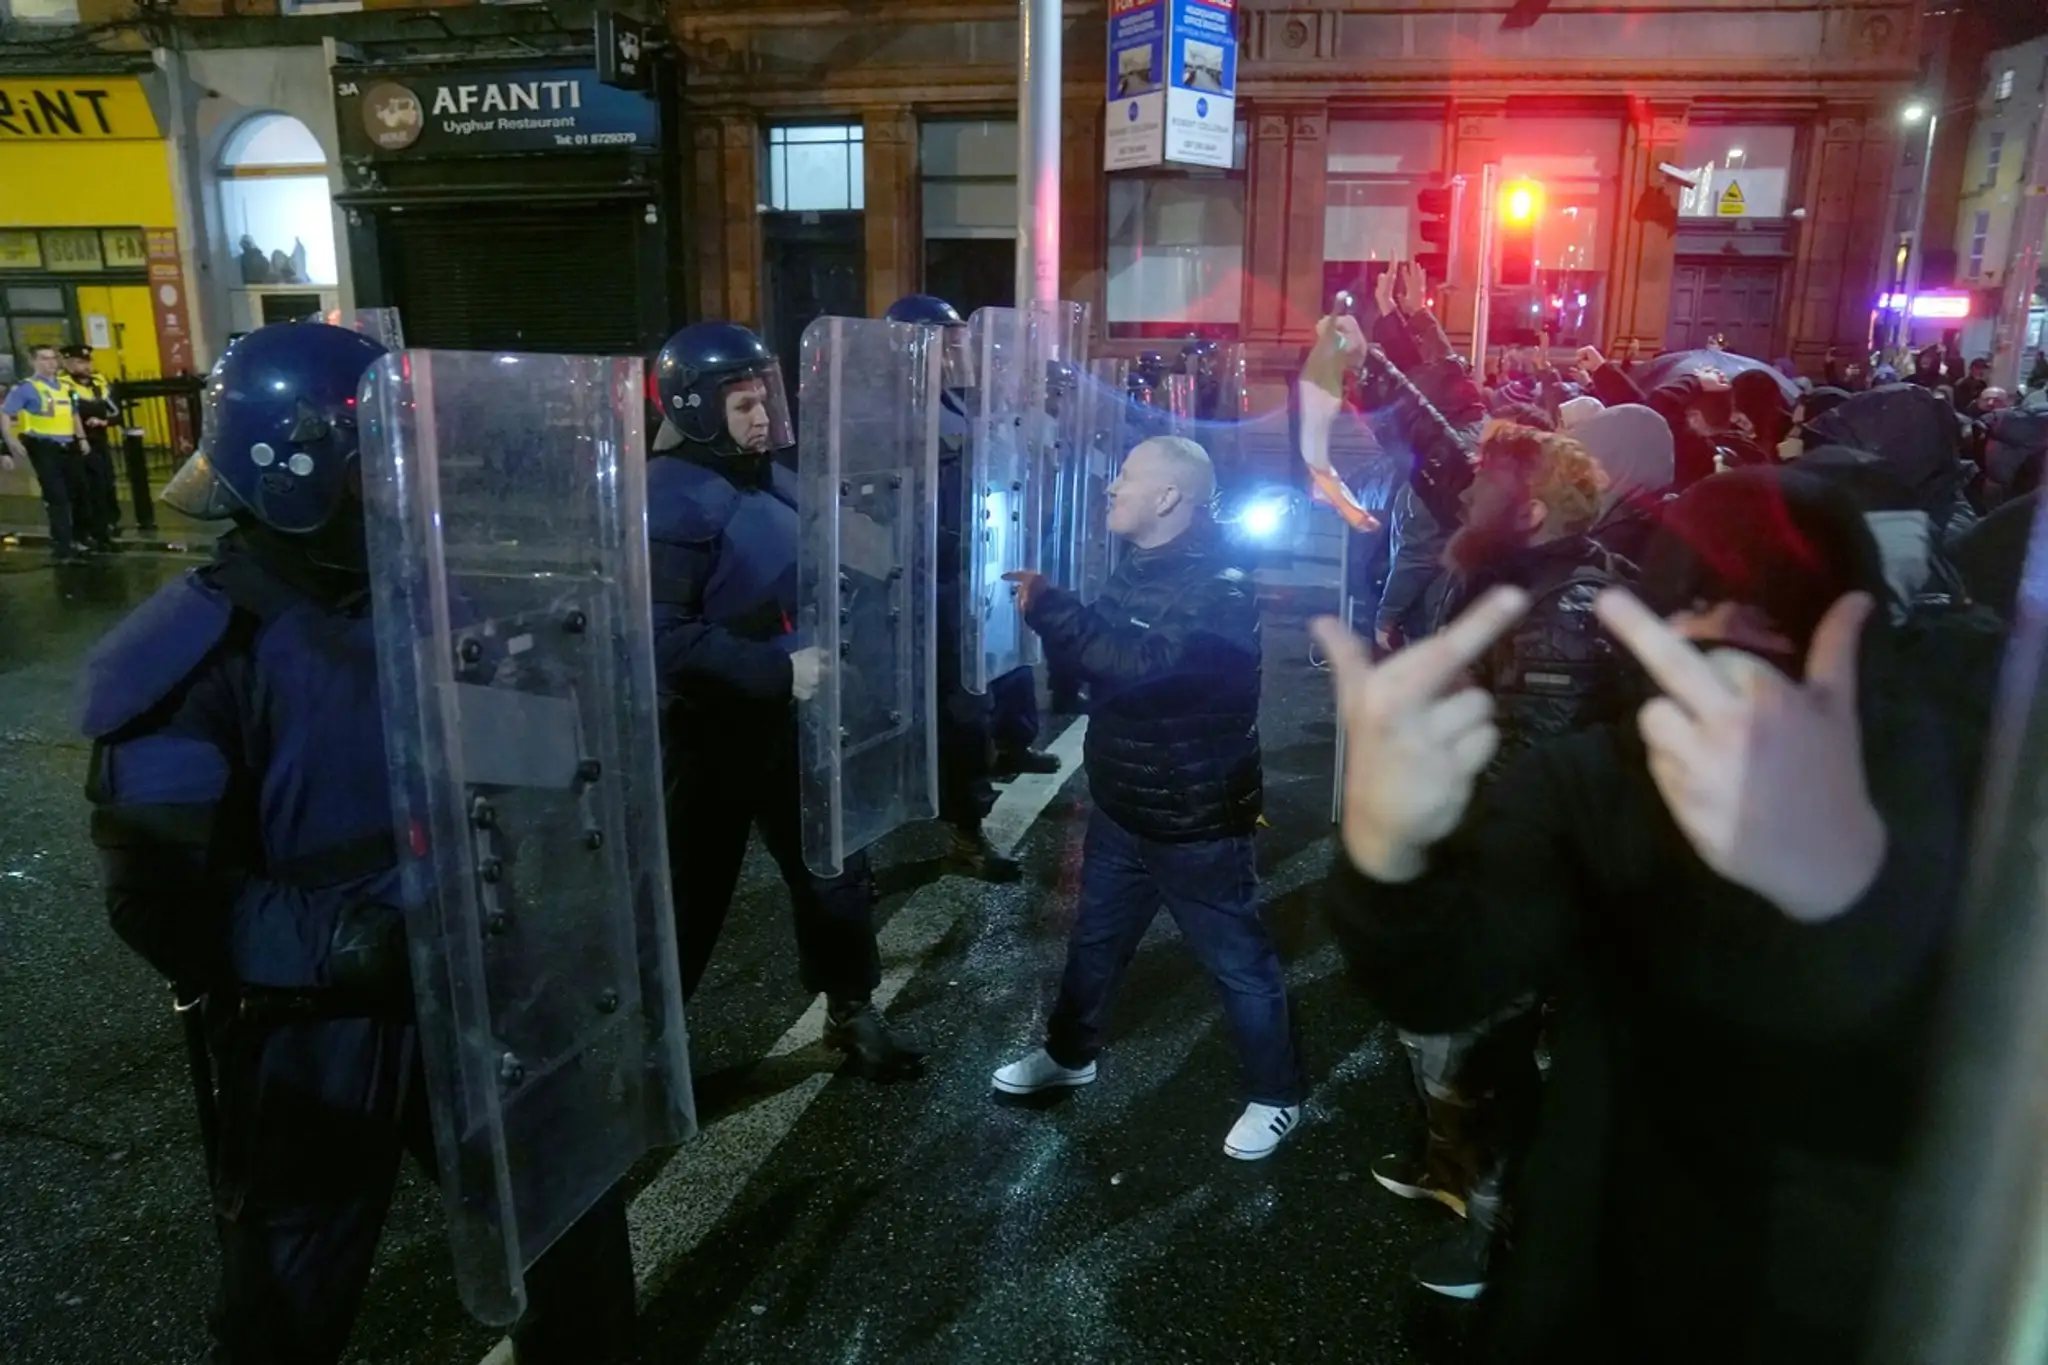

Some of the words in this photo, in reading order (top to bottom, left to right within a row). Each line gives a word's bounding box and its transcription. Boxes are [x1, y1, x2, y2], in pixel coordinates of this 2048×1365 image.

[431, 80, 581, 116] AFANTI
[443, 119, 495, 135] Uyghur
[498, 116, 576, 131] Restaurant
[575, 134, 588, 145] 01
[53, 237, 97, 261] SCAN
